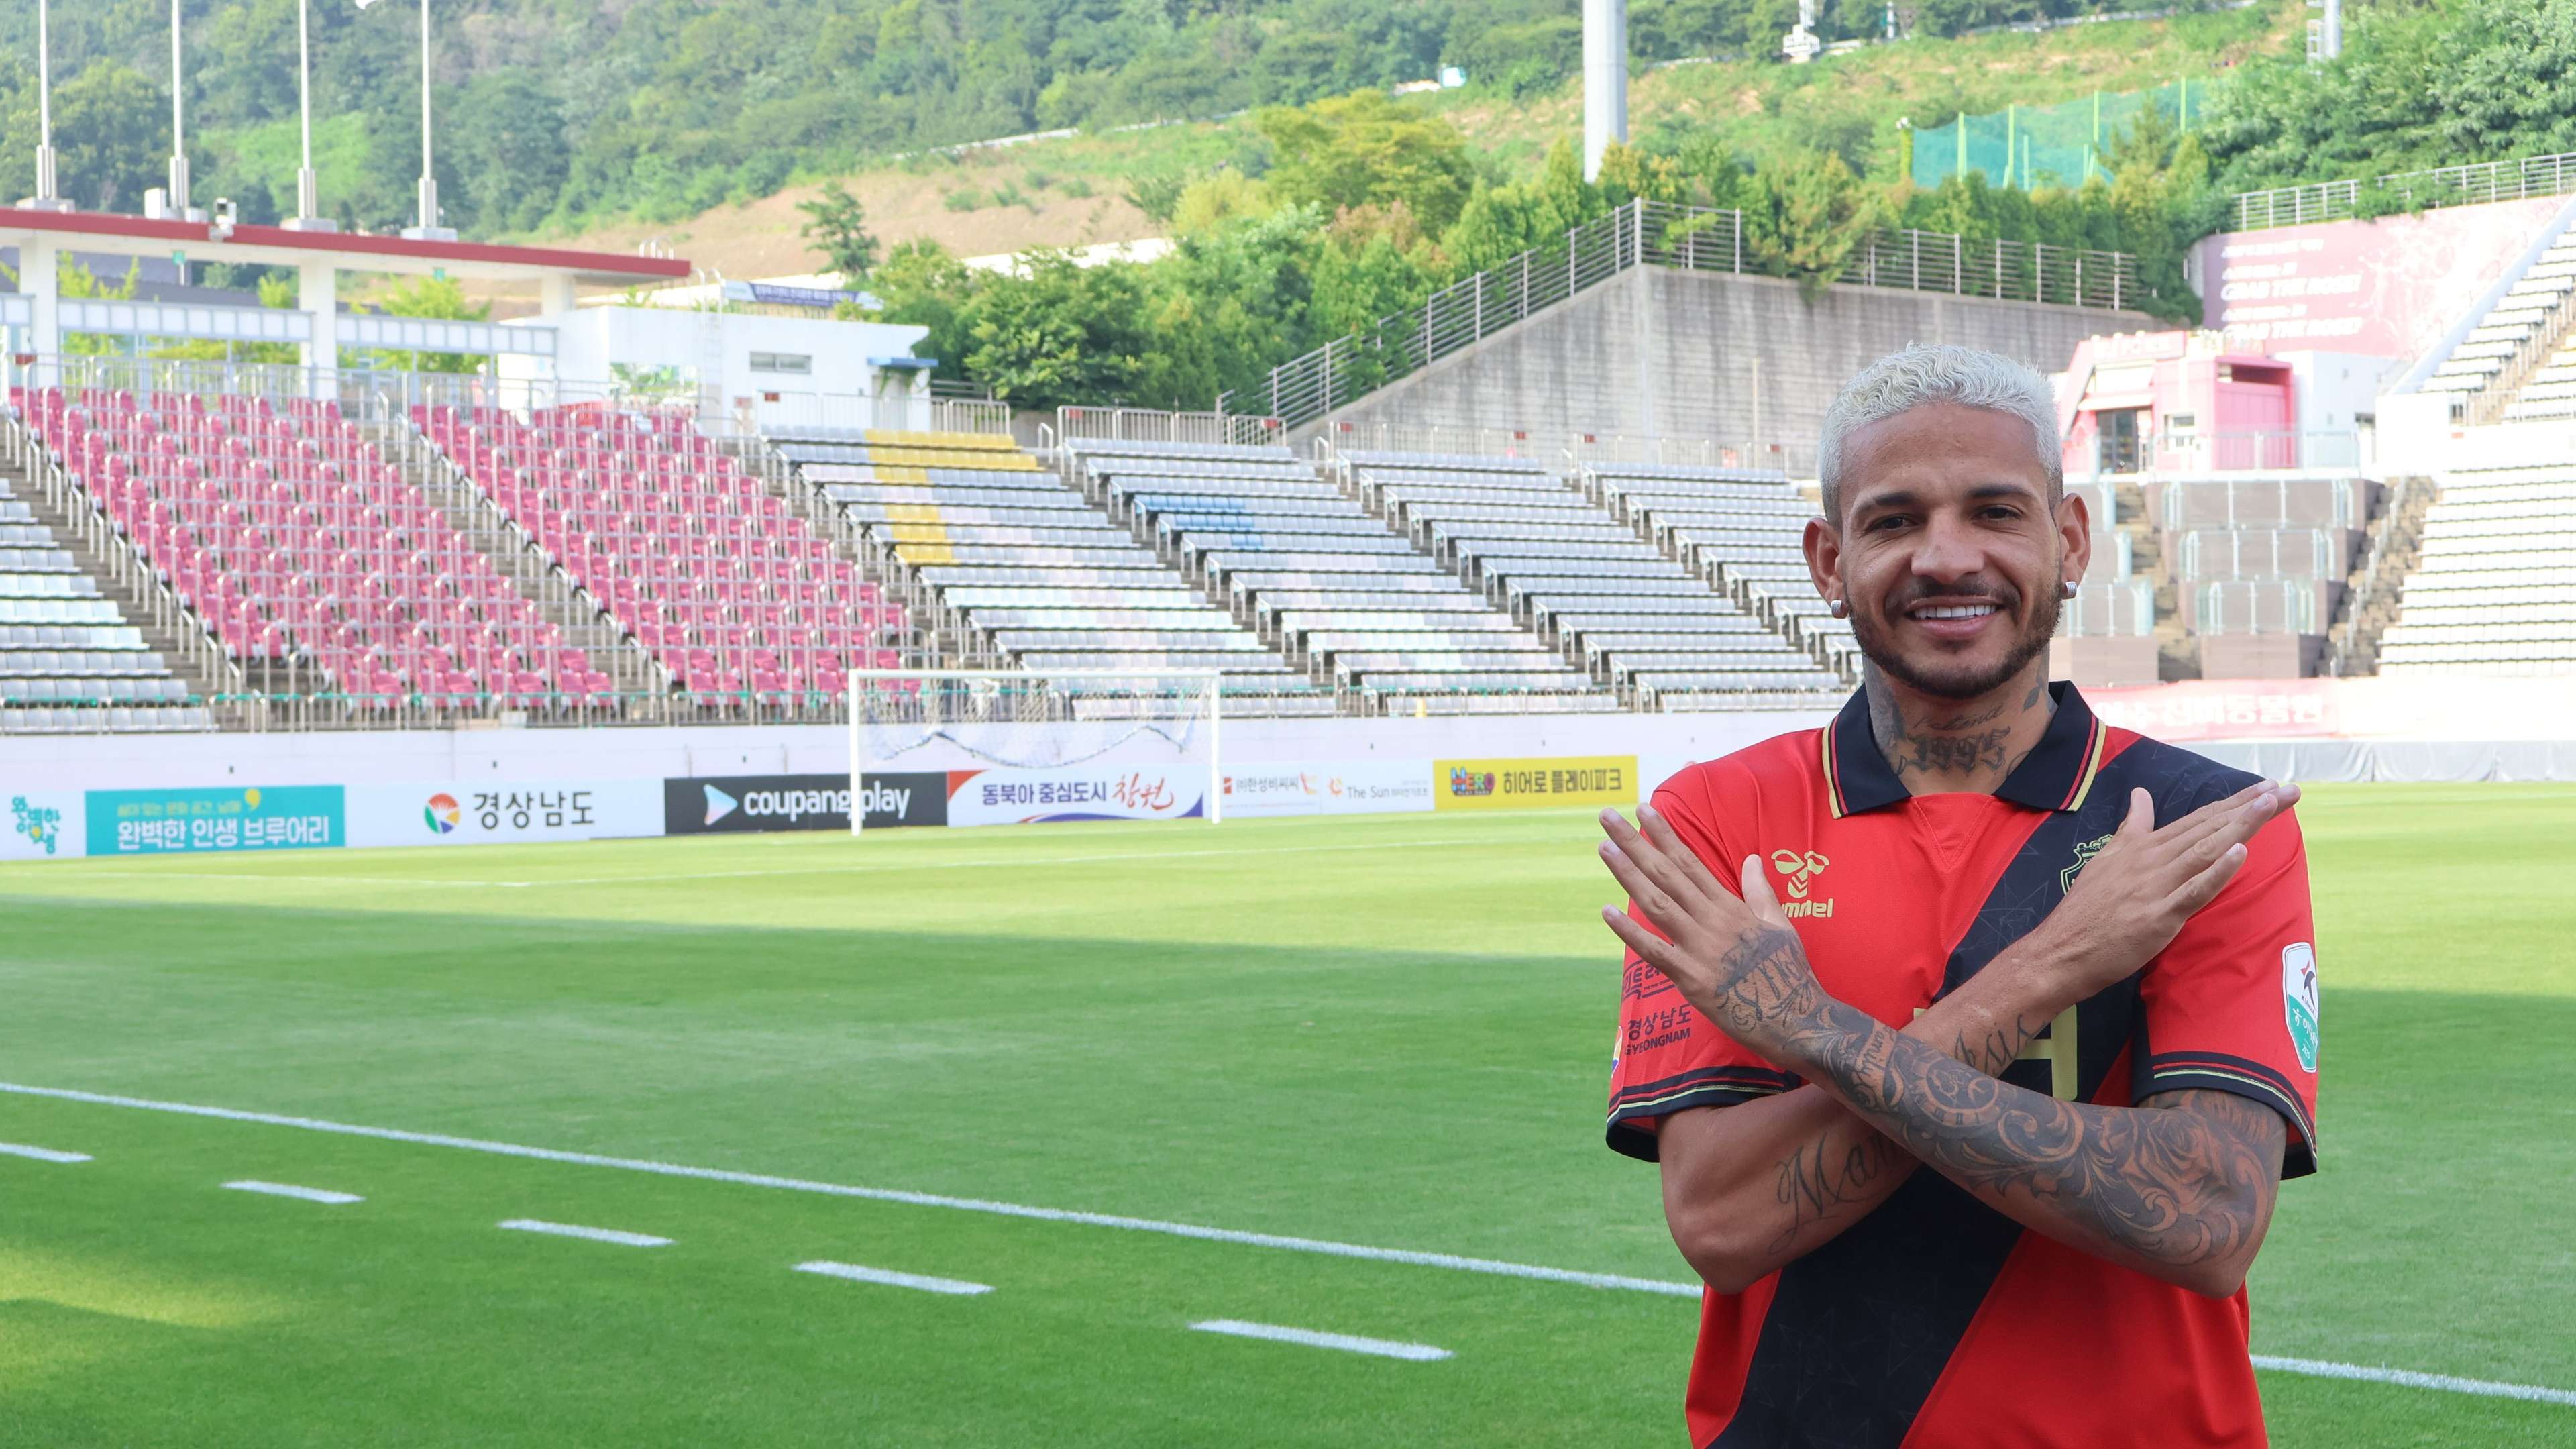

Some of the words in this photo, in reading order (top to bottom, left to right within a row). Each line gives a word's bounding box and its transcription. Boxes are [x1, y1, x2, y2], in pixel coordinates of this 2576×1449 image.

[983, 783, 1034, 806] 동북아
[1039, 781, 1106, 804] 중심도시
[1112, 773, 1175, 810] 창원
[1347, 786, 1366, 798] The
[1371, 786, 1390, 798] Sun
[1450, 767, 1495, 792] HERO
[474, 791, 594, 830] 경상남도
[744, 789, 851, 822] coupang
[118, 819, 187, 851] 완벽한
[191, 818, 238, 847] 인생
[244, 816, 329, 845] 브루어리
[1782, 898, 1833, 918] mmel
[1628, 1004, 1691, 1040] 경상남도
